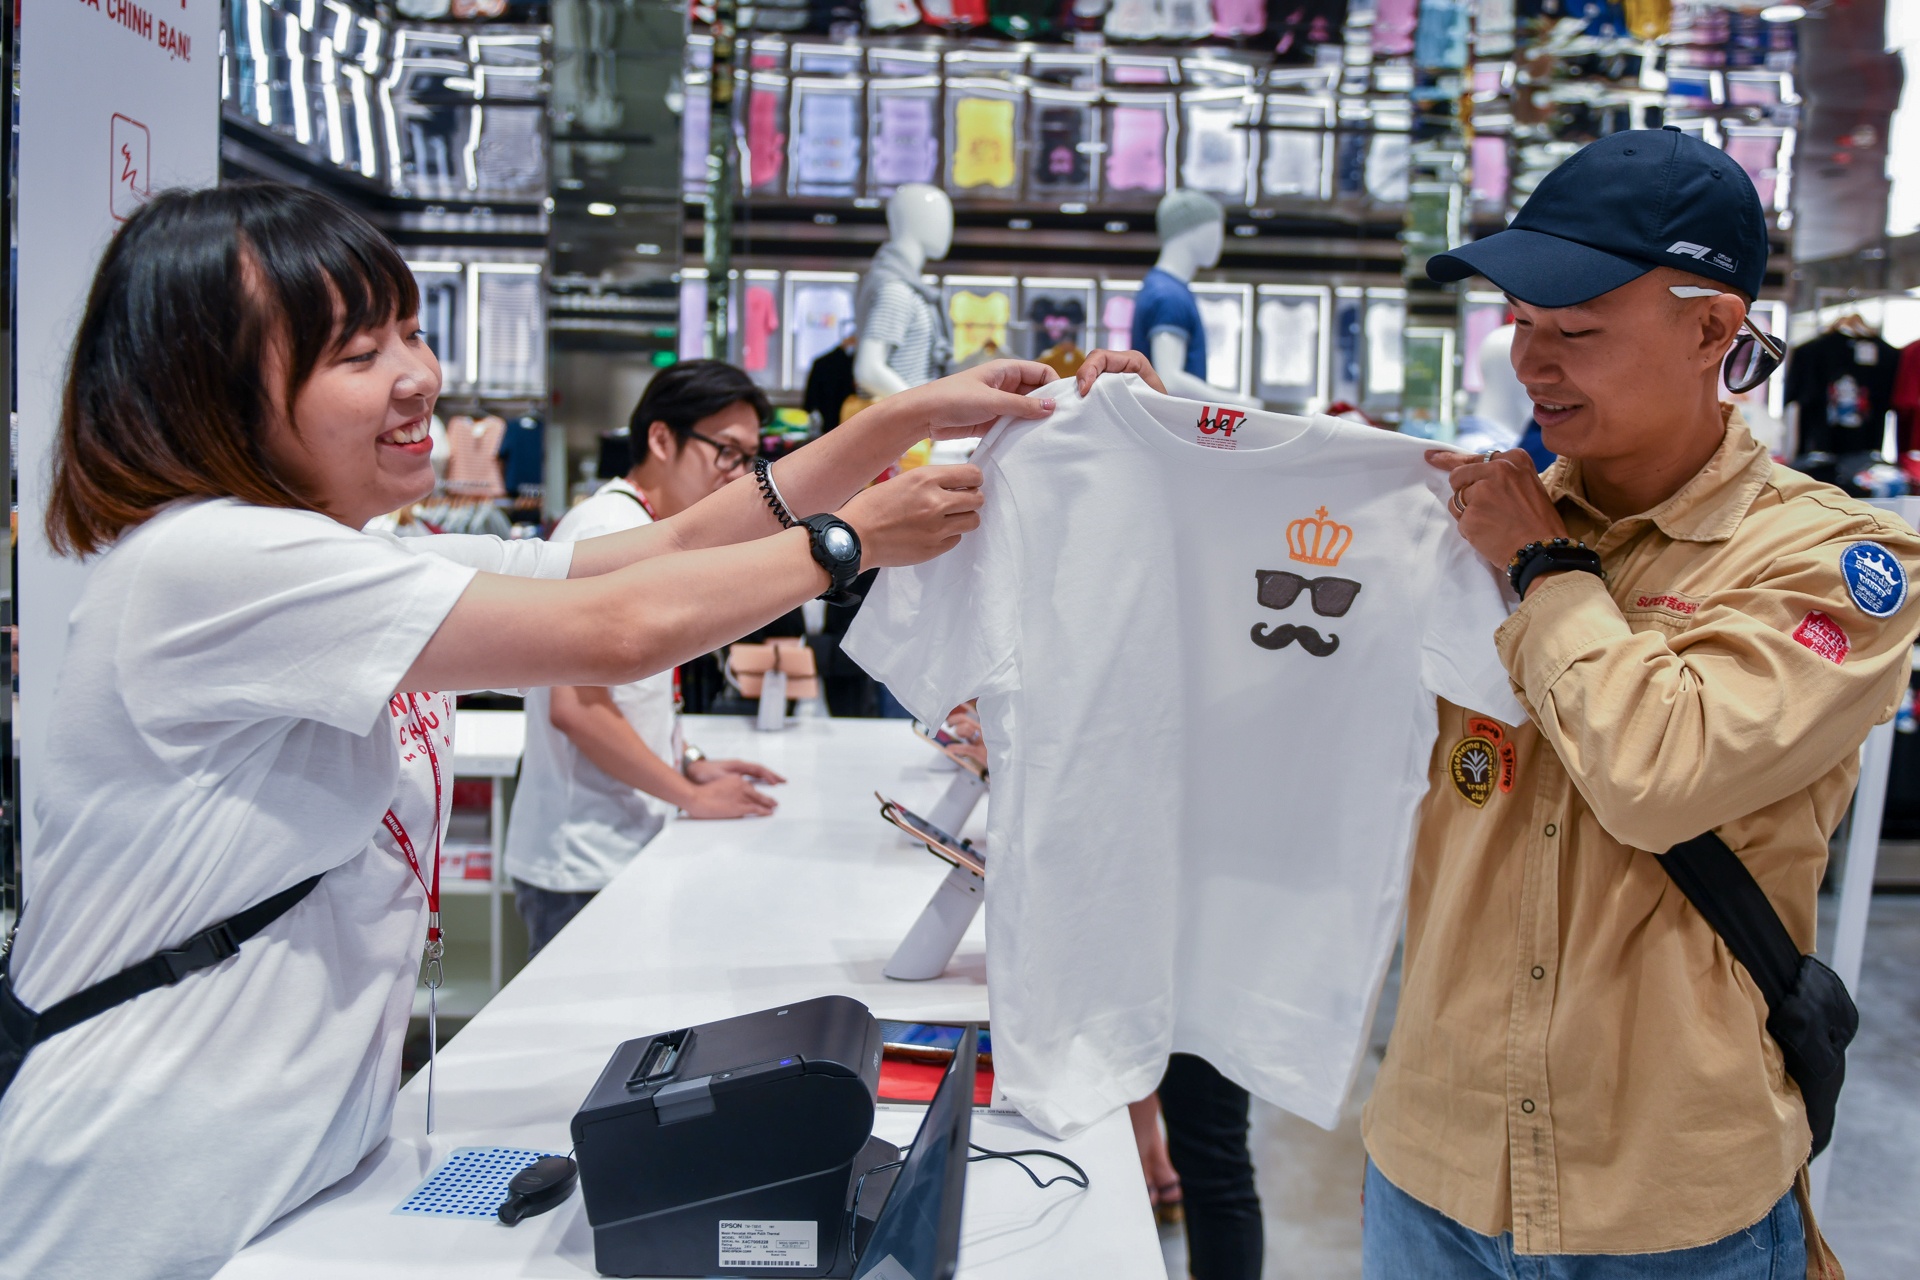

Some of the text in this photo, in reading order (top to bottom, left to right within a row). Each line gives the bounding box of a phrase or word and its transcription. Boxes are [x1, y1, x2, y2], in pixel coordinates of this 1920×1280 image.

[158, 19, 191, 62] BẠN!
[1666, 241, 1712, 260] F1
[1718, 252, 1732, 262] Official
[1713, 256, 1734, 269] Timepiece
[1197, 418, 1247, 432] me!
[1200, 406, 1245, 437] UT
[1854, 559, 1894, 595] Superdry
[1806, 620, 1842, 652] VALLEY
[1454, 742, 1480, 782] yokohama
[385, 814, 403, 837] UNIQLO
[404, 841, 416, 863] UNIQLO
